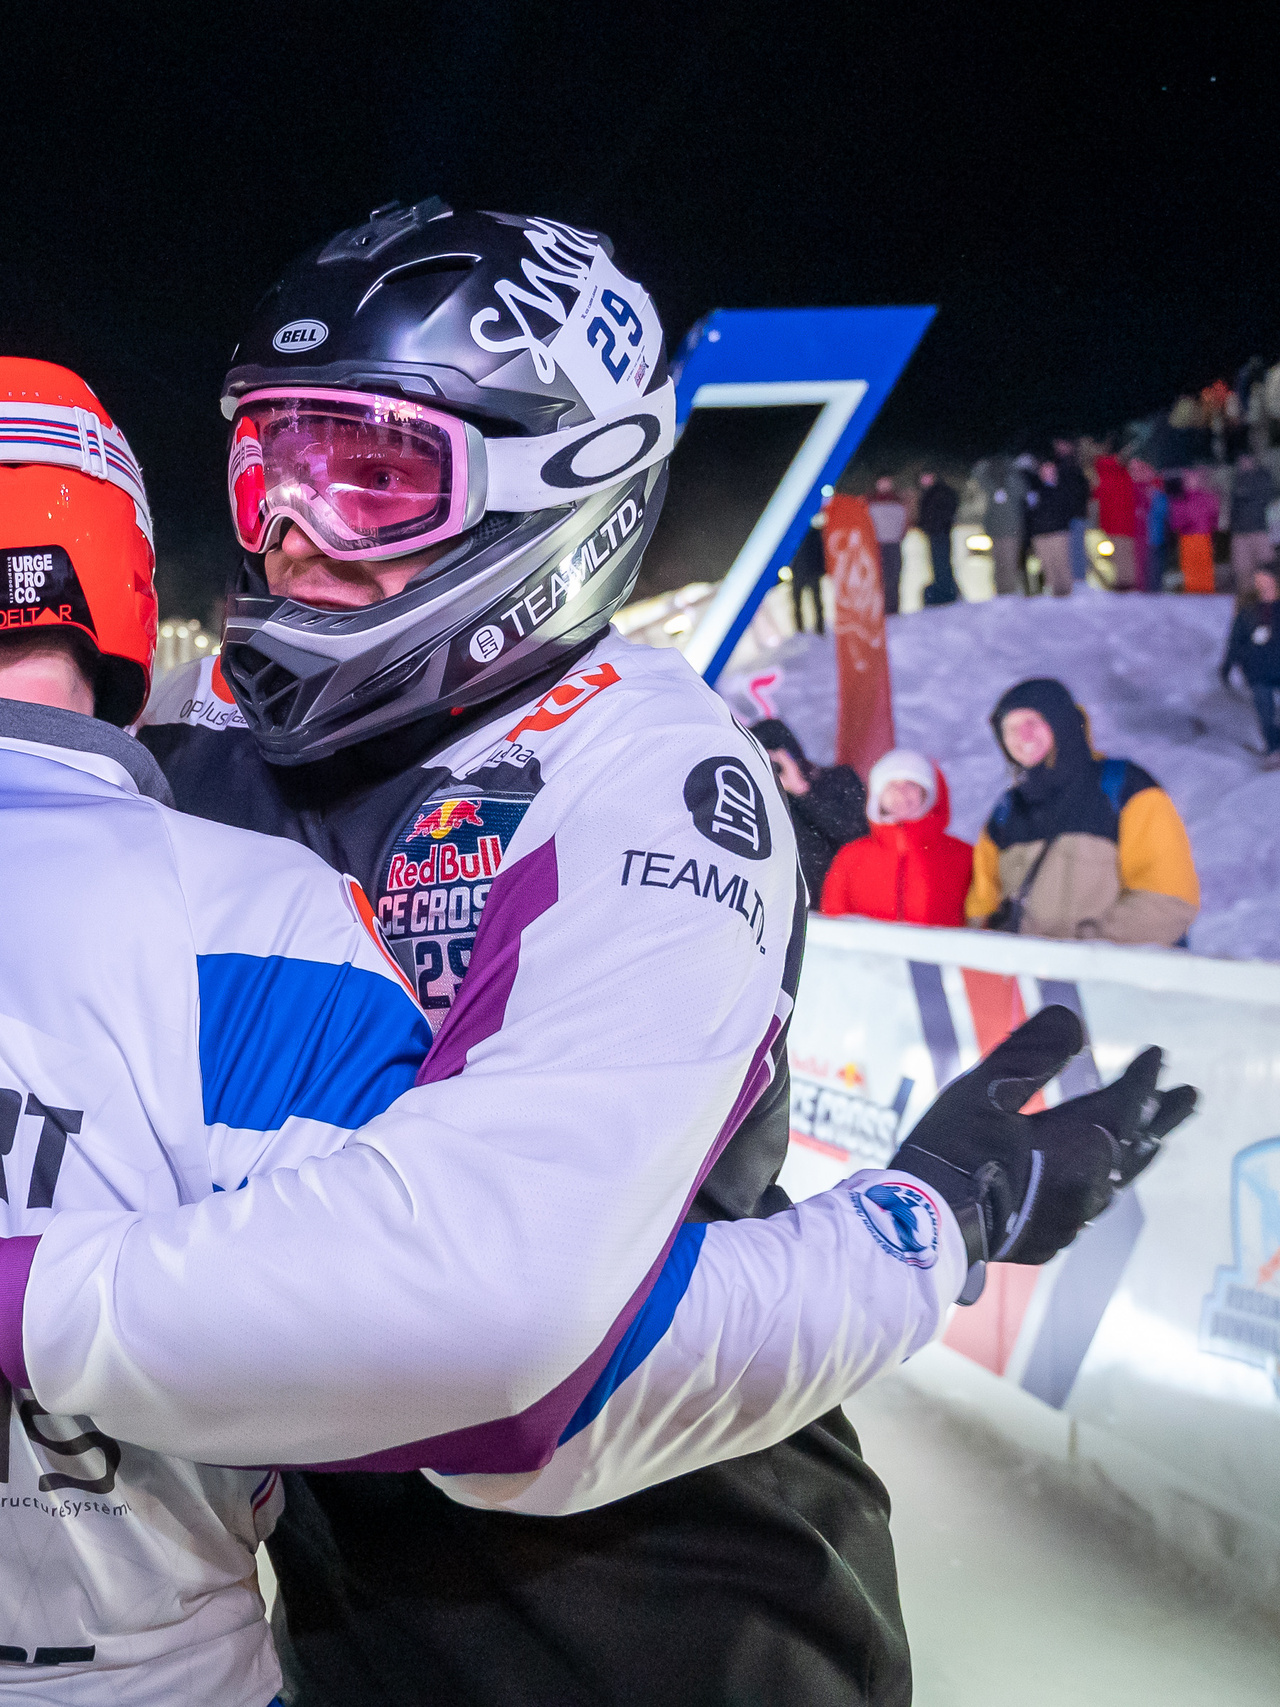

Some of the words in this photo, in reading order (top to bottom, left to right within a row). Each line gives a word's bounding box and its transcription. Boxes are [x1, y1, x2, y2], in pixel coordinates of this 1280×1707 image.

[280, 328, 318, 344] BELL
[586, 289, 643, 384] 29
[12, 553, 54, 573] URGE
[14, 571, 46, 589] PRO
[14, 587, 41, 604] CO.
[378, 893, 408, 936] CE
[63, 1499, 132, 1518] Systèm
